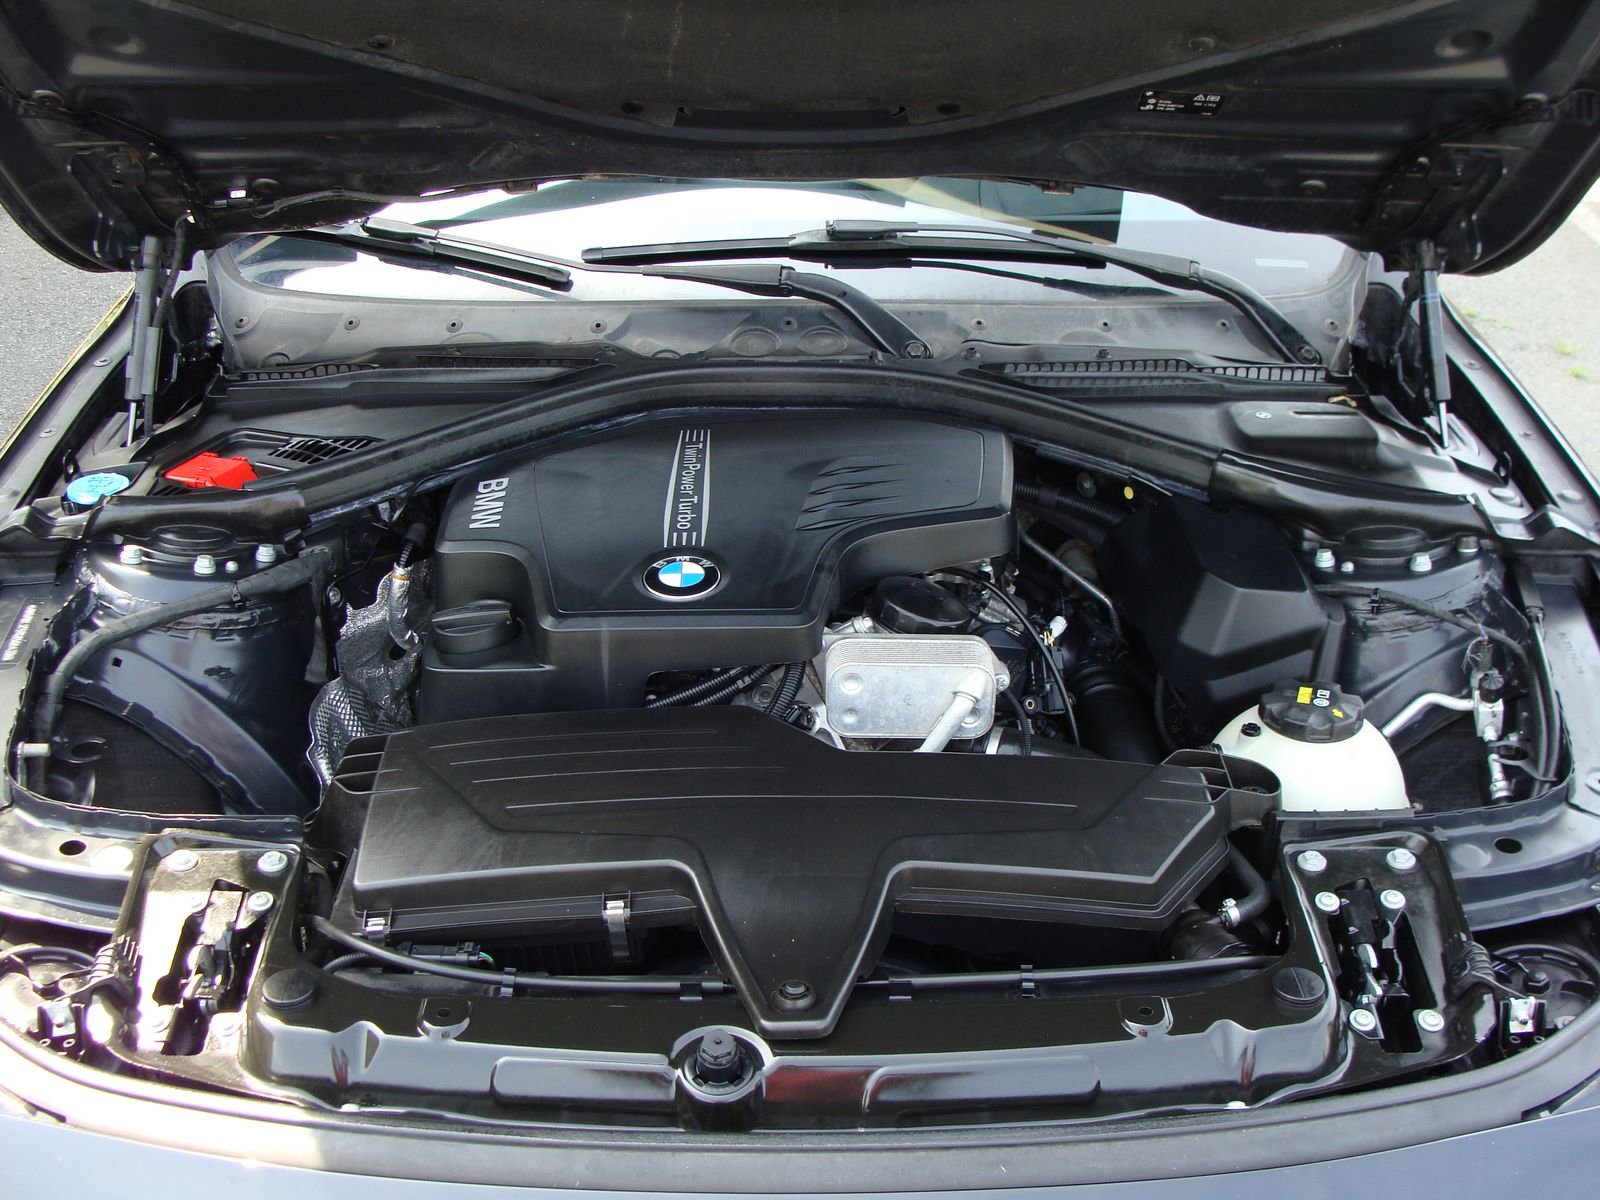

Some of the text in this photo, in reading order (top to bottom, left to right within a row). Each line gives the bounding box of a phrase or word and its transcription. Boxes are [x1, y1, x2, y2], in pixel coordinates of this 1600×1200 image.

[469, 477, 509, 528] BMW
[677, 495, 698, 530] Turbo
[654, 555, 714, 568] BMW
